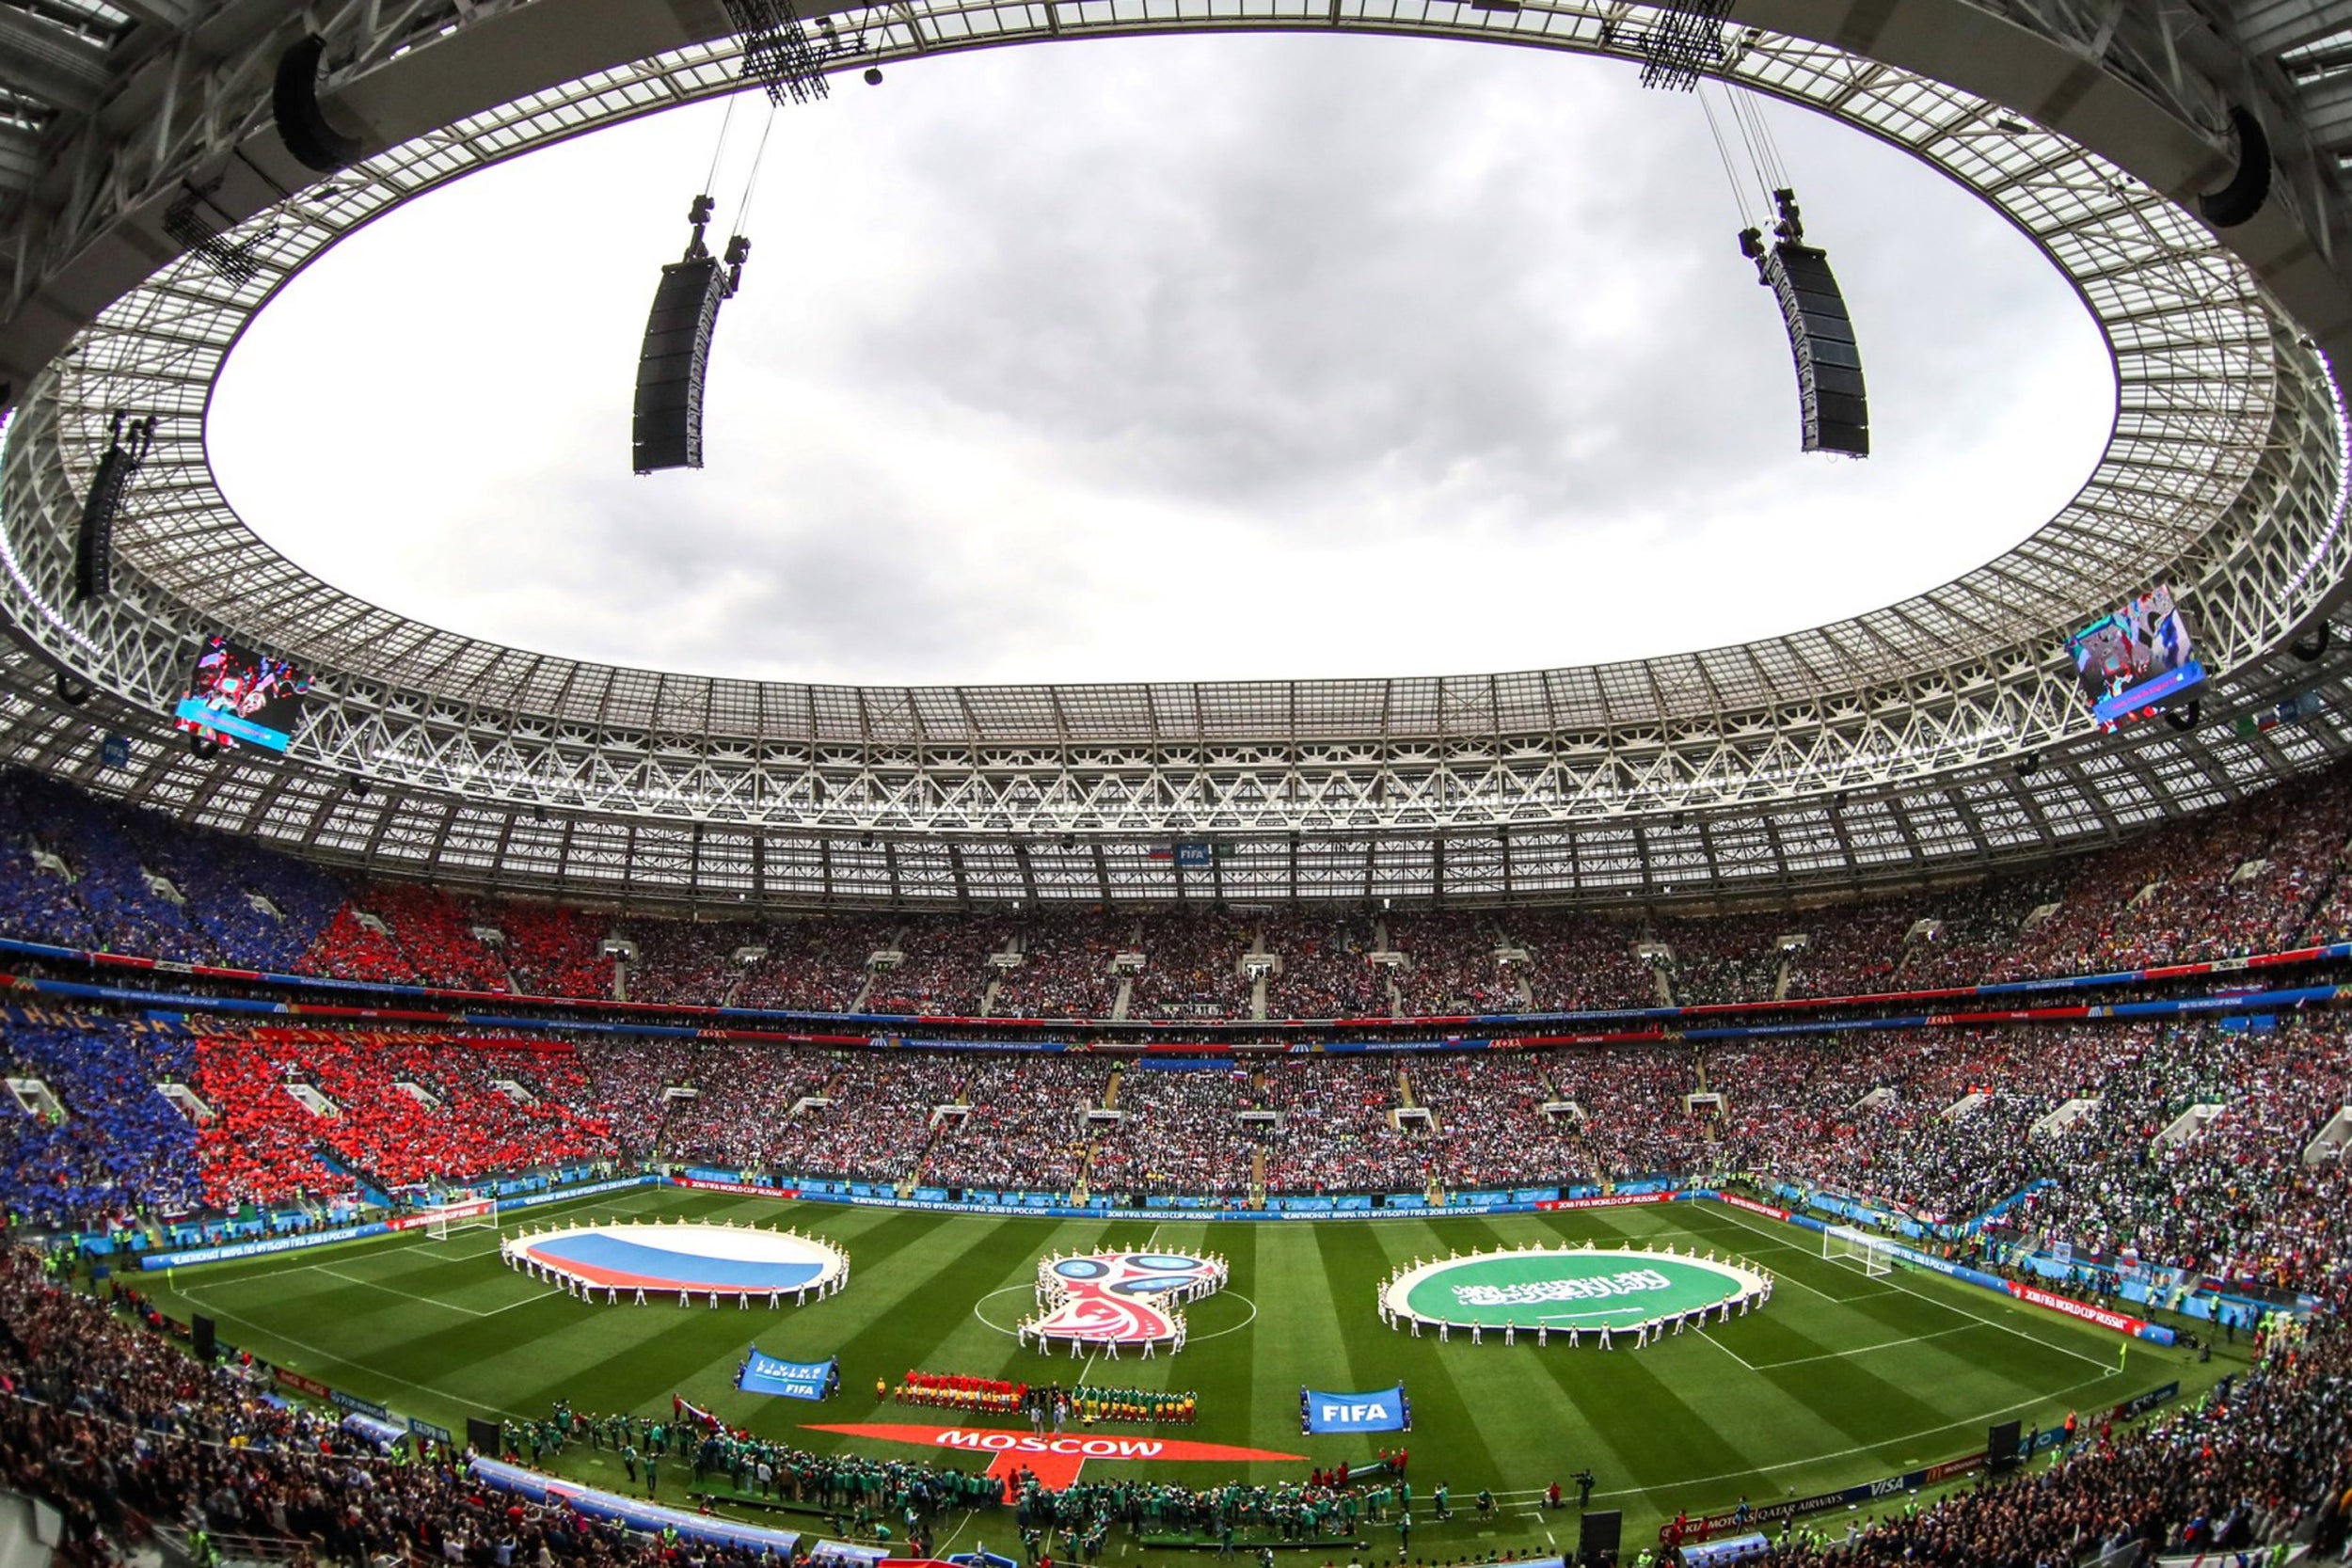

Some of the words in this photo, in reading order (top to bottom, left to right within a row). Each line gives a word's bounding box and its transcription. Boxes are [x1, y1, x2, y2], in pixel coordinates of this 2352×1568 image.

[1181, 849, 1204, 859] FIFA
[721, 1184, 742, 1193] WORLD
[851, 1196, 896, 1207] ЧЕМПИОНАТ
[898, 1199, 919, 1208] МИРА
[933, 1201, 968, 1211] ФУТБОЛУ
[970, 1203, 986, 1212] FIFA
[988, 1204, 1004, 1212] 2018
[1281, 1212, 1330, 1220] ЧЕМПИОНАТ
[2026, 1290, 2041, 1302] 2018
[2042, 1294, 2055, 1307] FIFA
[2056, 1299, 2079, 1314] WORLD
[2081, 1307, 2095, 1319] CUP
[755, 1366, 818, 1380] FOOTBALL
[759, 1360, 821, 1374] LIVING
[786, 1384, 814, 1395] FIFA
[1322, 1403, 1388, 1422] FIFA
[936, 1431, 1163, 1456] MOSCOW
[1870, 1476, 1904, 1496] VISA
[1758, 1504, 1796, 1520] QATAR
[1797, 1494, 1843, 1512] AIRWAYS
